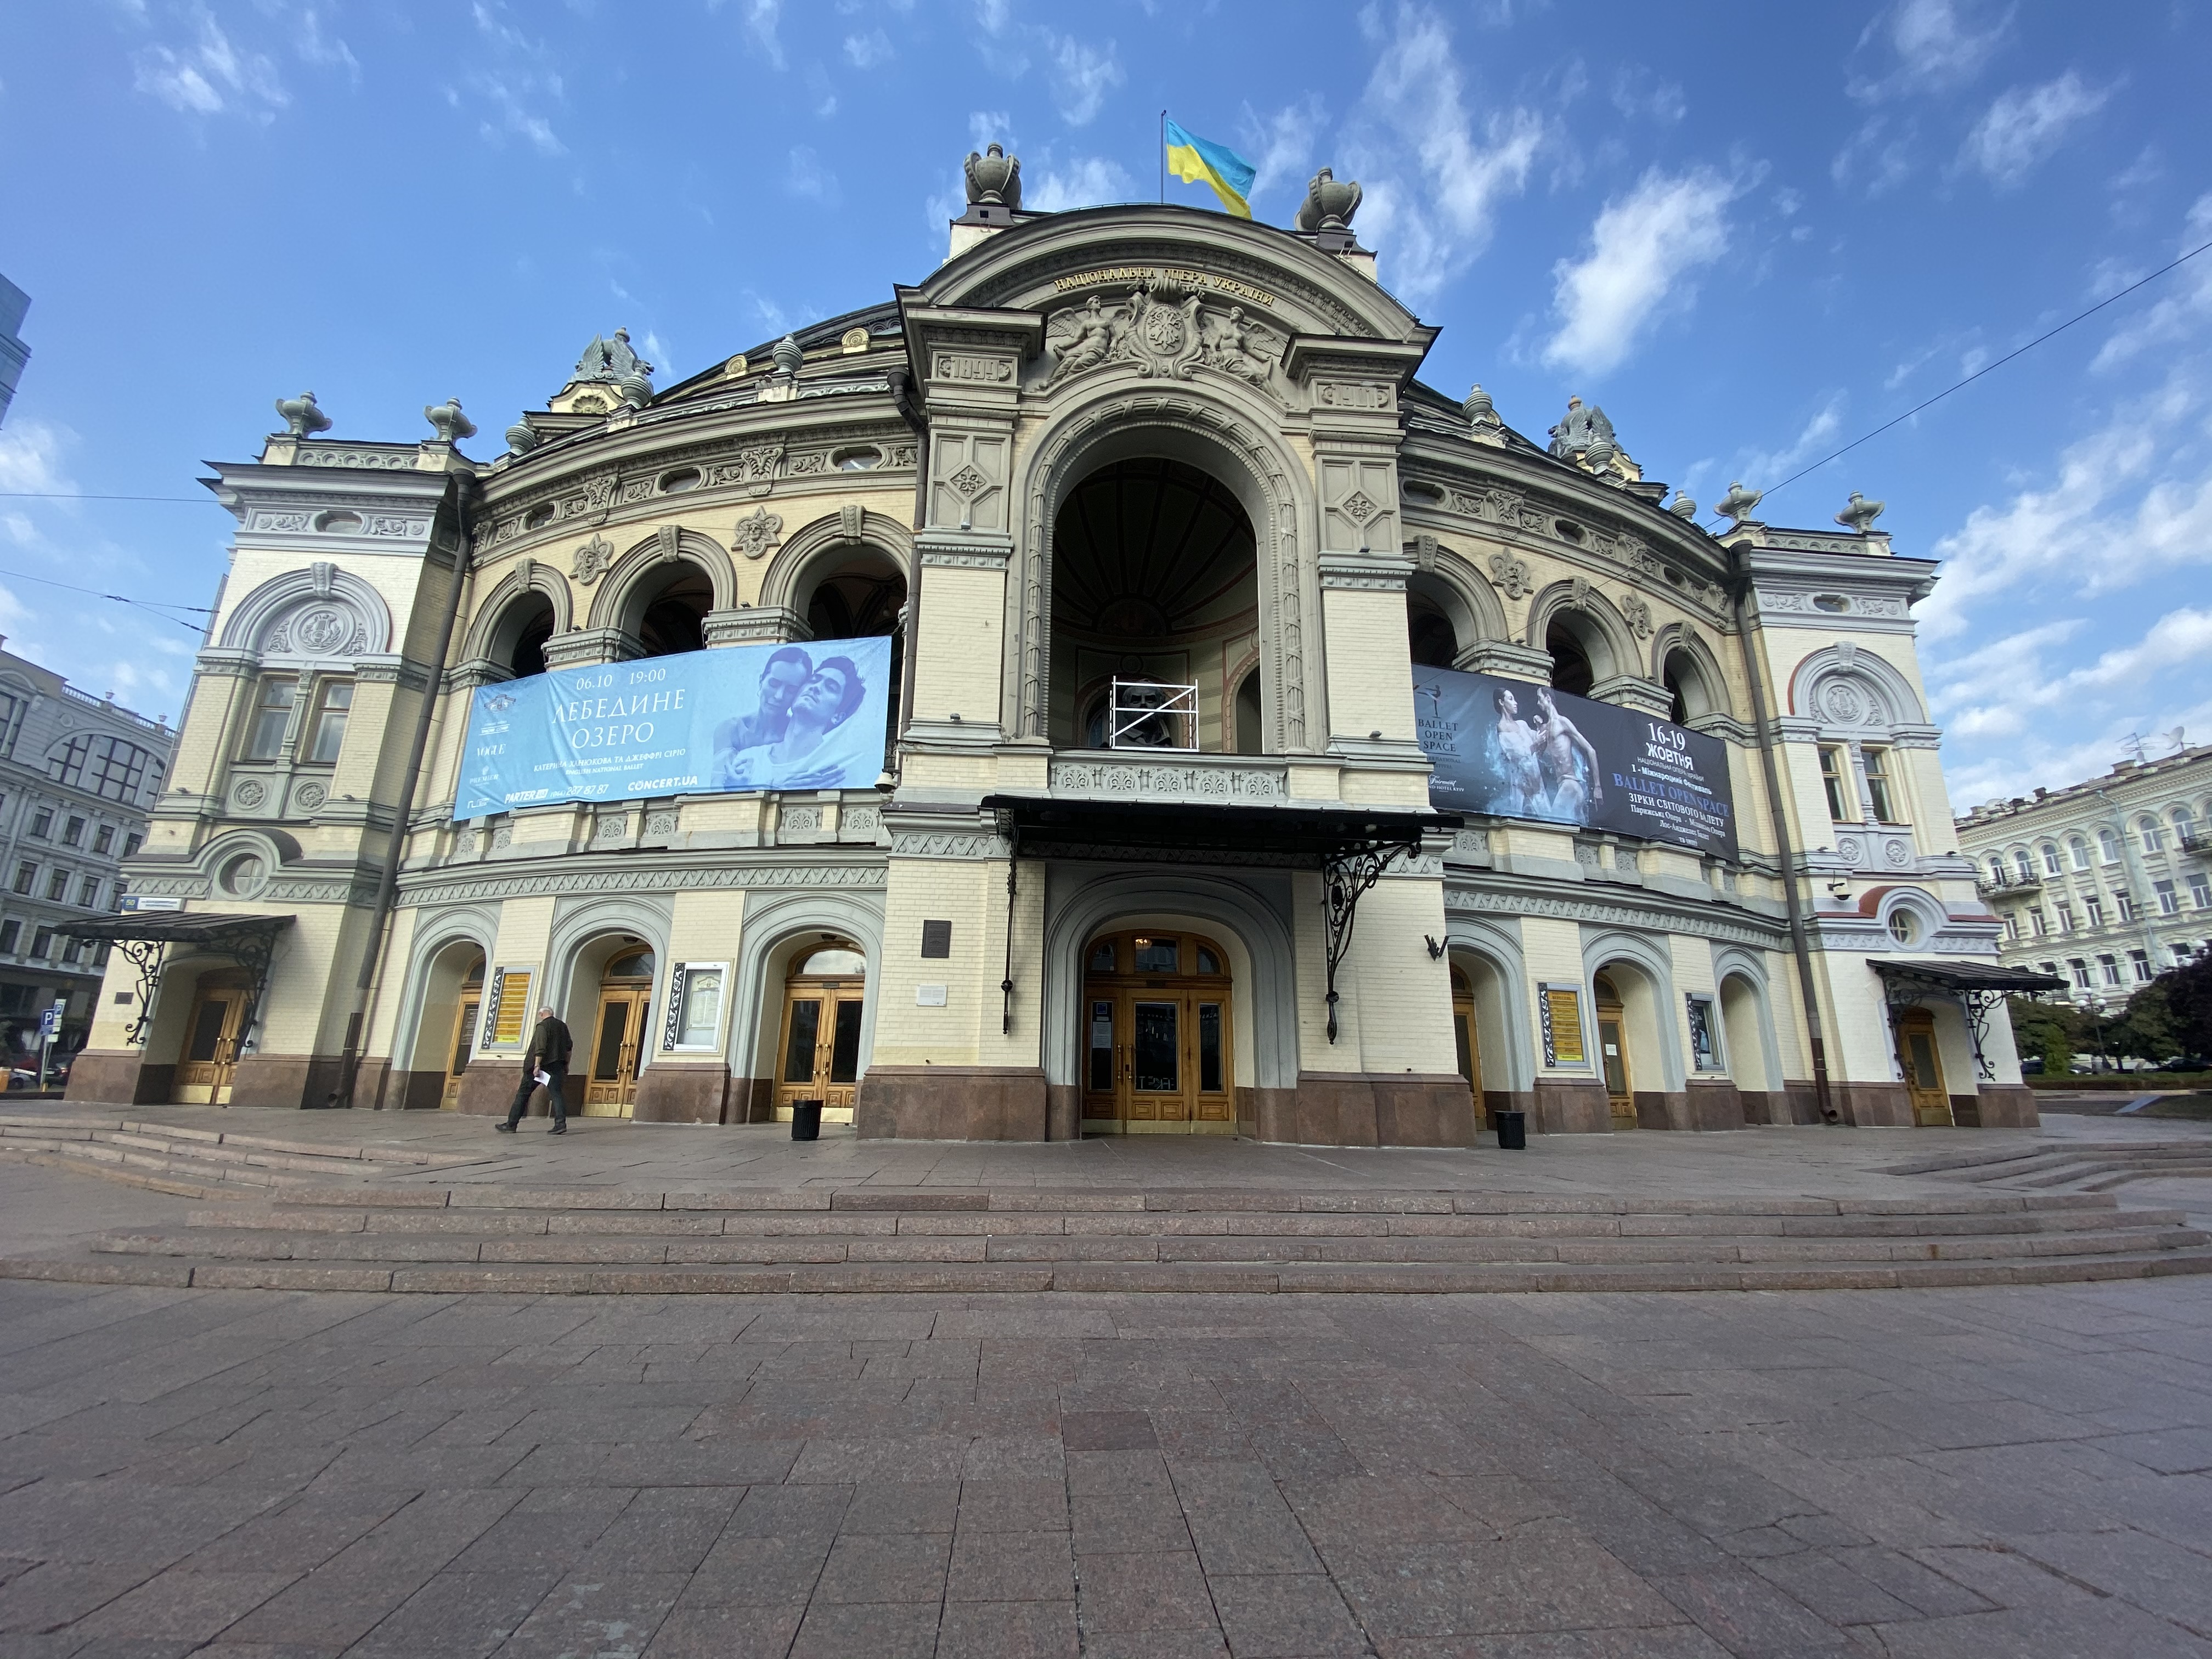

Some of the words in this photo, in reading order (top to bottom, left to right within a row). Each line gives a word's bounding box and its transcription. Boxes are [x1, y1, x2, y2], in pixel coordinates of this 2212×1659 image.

[1054, 268, 1156, 292] НАЦІОНАЛЬНА
[1163, 269, 1207, 285] ОПЕРА
[951, 357, 998, 380] 1899
[1331, 384, 1378, 408] 1901
[576, 674, 613, 690] 06.10
[630, 668, 666, 685] 19:00
[551, 689, 685, 724] ЛЕБЕДИНЕ
[572, 722, 654, 749] ОЗЕРО
[1418, 719, 1458, 731] BALLET
[1425, 730, 1453, 741] OPEN
[1647, 722, 1686, 751] 16-19
[477, 744, 506, 757] VOGUE
[1424, 741, 1456, 752] SPACE
[1646, 742, 1694, 771] ЖОВТНЯ
[534, 761, 567, 772] КАТЕРИНА
[569, 757, 612, 768] ХАНЮКОВА
[625, 752, 662, 763] ДЖЕФФРІ
[664, 748, 686, 758] СІРІО
[592, 764, 622, 774] NATIONAL
[566, 785, 583, 796] 287
[583, 785, 597, 795] 87
[597, 784, 610, 794] 87
[628, 776, 698, 791] CONCERT.UA
[1612, 773, 1666, 797] BALLET
[1641, 766, 1683, 785] Міжнародний
[1683, 778, 1712, 795] Фестиваль
[1629, 792, 1655, 806] ЗІРКИ
[1657, 799, 1699, 819] СВІТОВОГО
[44, 1012, 53, 1025] P
